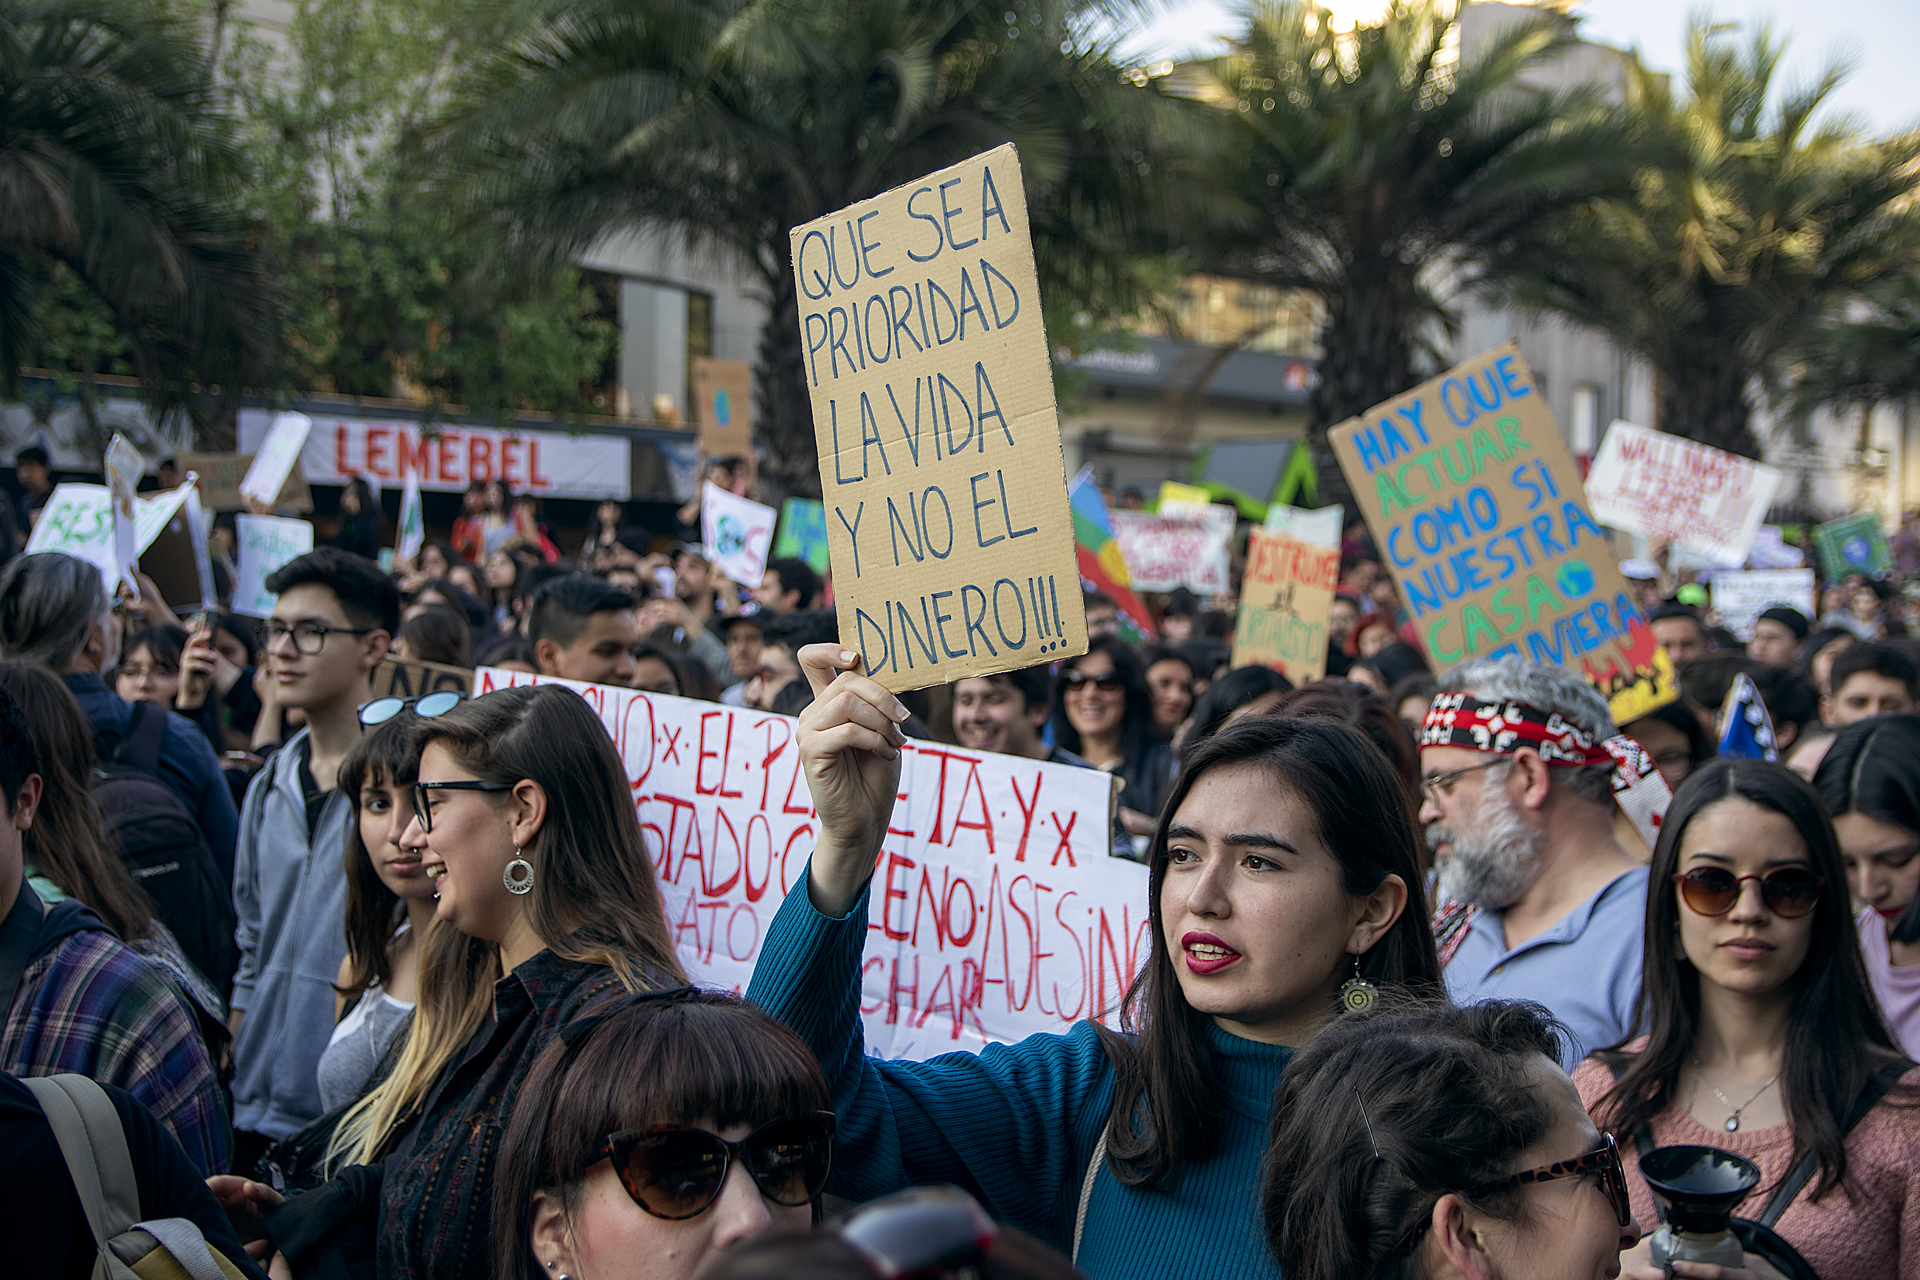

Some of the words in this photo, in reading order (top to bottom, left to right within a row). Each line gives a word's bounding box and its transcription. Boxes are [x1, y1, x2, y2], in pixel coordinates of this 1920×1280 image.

[799, 209, 895, 300] QUE
[906, 165, 1011, 262] SEA
[804, 258, 1020, 388] PRIORIDAD
[336, 422, 551, 488] LEMEBEL
[829, 390, 892, 485] LA
[885, 360, 1015, 468] VIDA
[1351, 398, 1431, 472] HAY
[1440, 354, 1532, 428] QUE
[1373, 415, 1533, 519] ACTUAR
[834, 500, 864, 578] Y
[886, 485, 954, 567] NO
[969, 468, 1038, 549] EL
[1386, 484, 1499, 570] COMO
[1402, 499, 1605, 618] NUESTRA
[855, 574, 1069, 678] DINERO!!!
[1426, 572, 1566, 664] CASA
[695, 711, 744, 799] EL
[753, 715, 997, 856] PLTA
[635, 792, 774, 904] STADO
